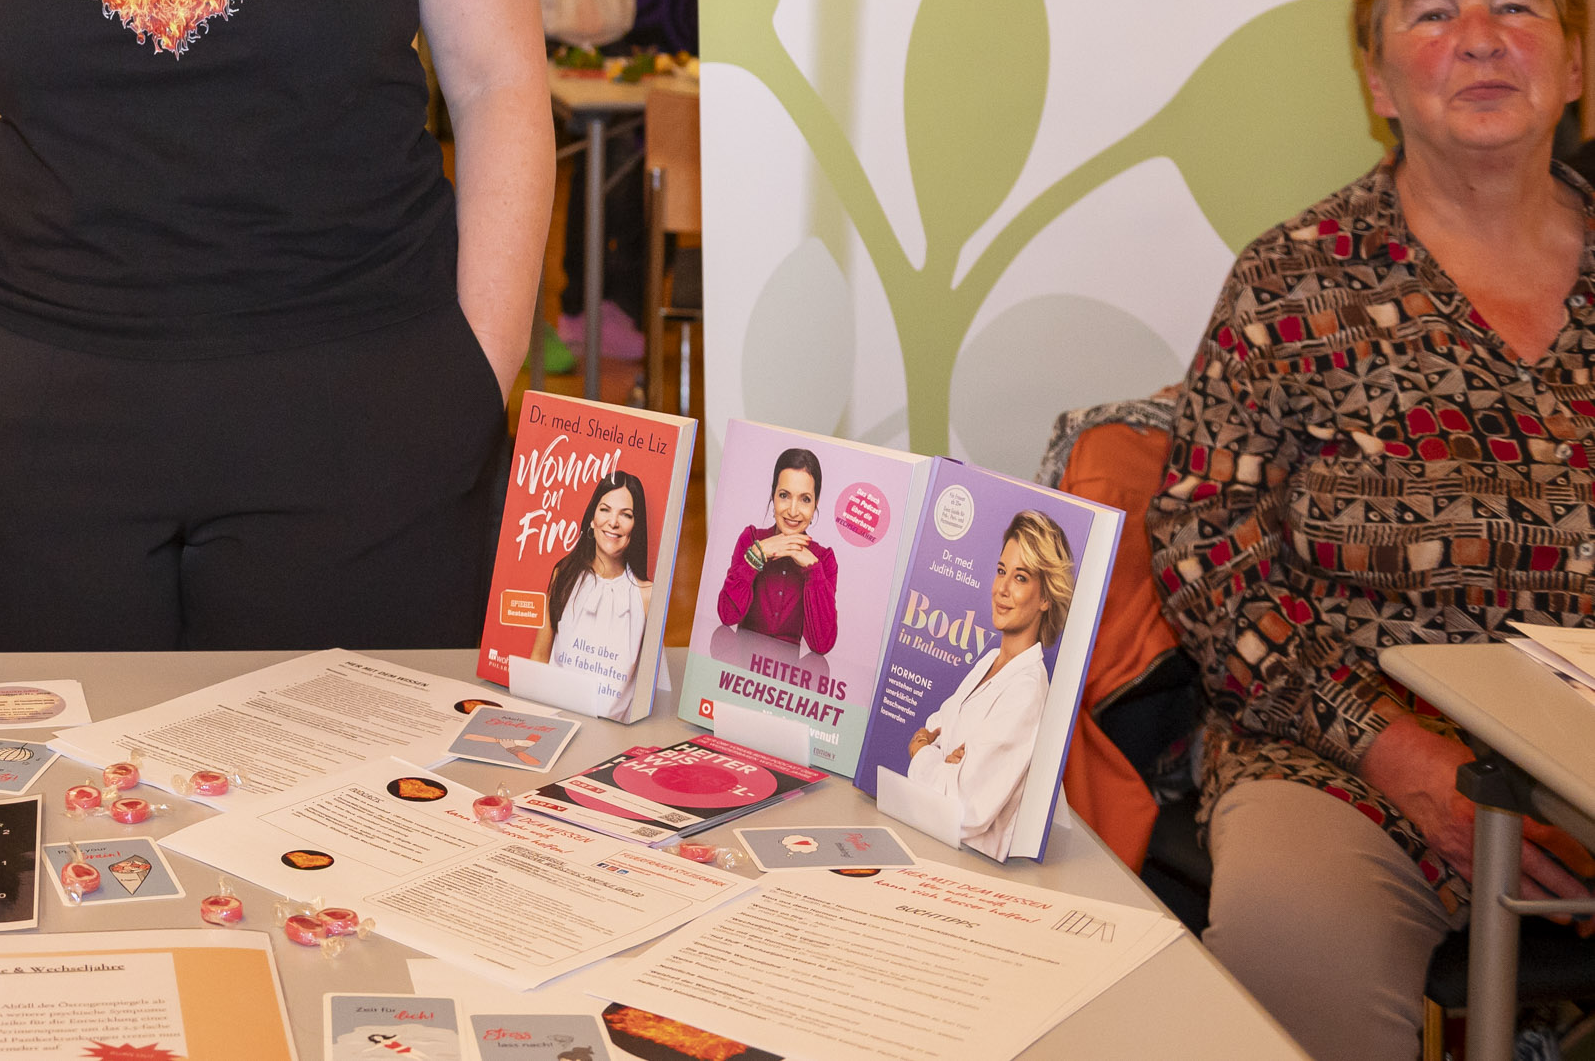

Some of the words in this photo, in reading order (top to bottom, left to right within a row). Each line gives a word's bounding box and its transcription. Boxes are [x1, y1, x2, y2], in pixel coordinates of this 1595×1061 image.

[529, 404, 548, 427] Dr.
[551, 415, 583, 435] med.
[586, 418, 624, 445] Sheila
[627, 429, 644, 449] de
[648, 432, 668, 455] Liz
[517, 434, 622, 495] Woman
[541, 487, 564, 511] on
[856, 487, 867, 498] Das
[867, 493, 881, 505] Buch
[859, 500, 882, 516] Podcast
[842, 511, 875, 533] wunderbaren
[850, 505, 864, 517] über
[863, 512, 873, 521] die
[515, 509, 584, 562] Fire
[835, 516, 877, 543] WECHSELJAHRE
[942, 548, 953, 564] Dr.
[954, 555, 975, 571] med.
[929, 560, 954, 579] Judith
[955, 570, 981, 589] Bildau
[507, 609, 538, 619] Bestseller
[901, 589, 997, 665] Body
[572, 637, 595, 655] Alles
[597, 645, 619, 662] über
[898, 629, 911, 646] in
[911, 636, 962, 667] Balance
[558, 651, 573, 666] die
[574, 656, 628, 684] fabelhaften
[750, 653, 813, 691] HEITER
[817, 674, 848, 702] BIS
[890, 663, 933, 691] HORMONE
[597, 682, 622, 700] jahre
[718, 670, 845, 727] WECHSELHAFT
[885, 686, 918, 707] unerklärliche
[888, 676, 913, 694] verstehen
[912, 685, 924, 699] und
[880, 706, 907, 725] loswerden
[882, 696, 917, 718] Beschwerden
[809, 727, 839, 745] venuti
[657, 748, 700, 766] BIS
[675, 743, 758, 775] HEITER
[873, 879, 908, 892] kann
[911, 888, 939, 900] sich
[942, 896, 985, 911] besser
[988, 907, 1042, 925] helfen!
[929, 875, 958, 888] MIT
[956, 881, 994, 897] DEM
[993, 891, 1054, 911] WISSEN
[944, 888, 976, 900] mehr
[895, 905, 982, 930] BUCHTIPPS
[30, 963, 126, 974] Wechseljahre
